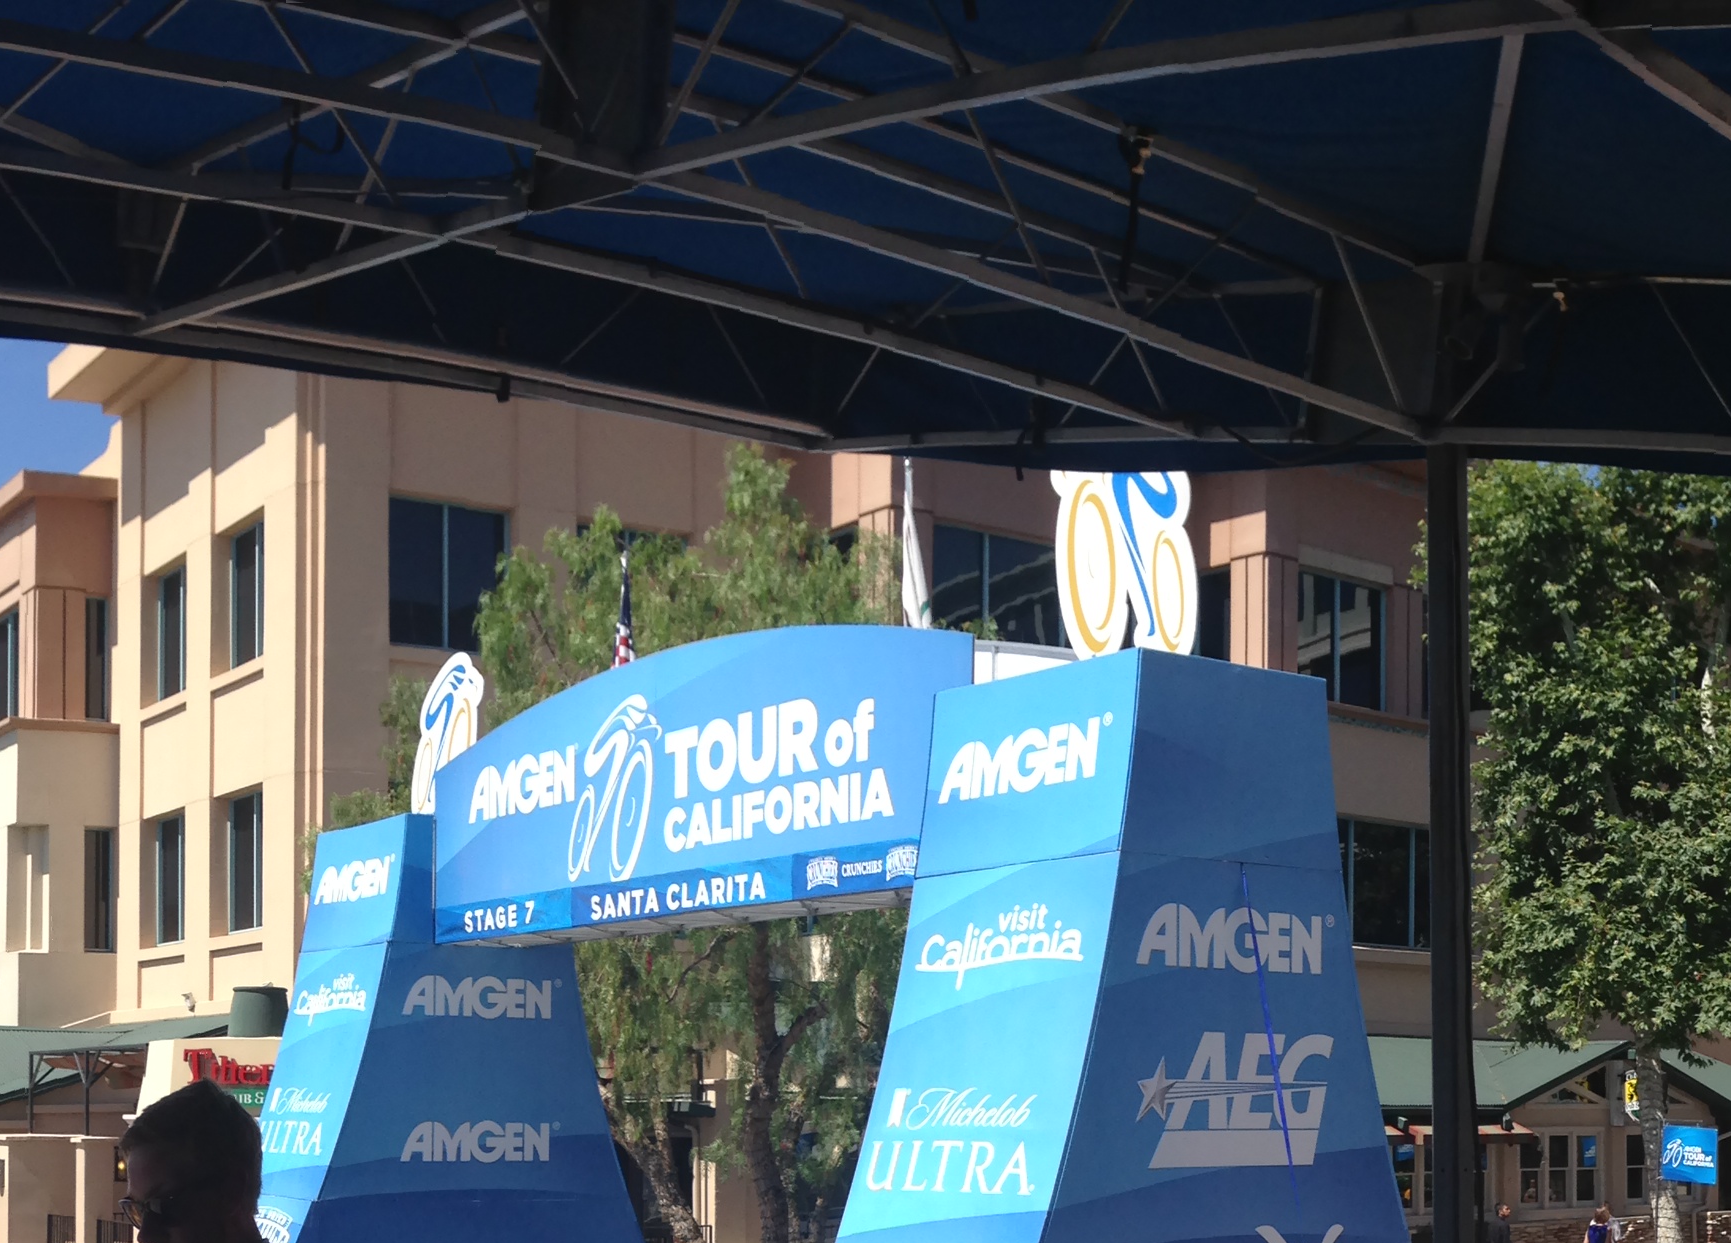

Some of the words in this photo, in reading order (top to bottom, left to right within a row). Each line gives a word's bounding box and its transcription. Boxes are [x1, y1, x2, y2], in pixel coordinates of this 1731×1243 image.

[664, 698, 819, 799] TOUR
[824, 698, 875, 768] of
[938, 716, 1101, 805] AMGEN
[468, 743, 576, 824] AMGEN
[663, 768, 895, 853] CALIFORNIA
[314, 855, 389, 905] AMGEN
[841, 860, 883, 878] CRUNCHIES
[464, 908, 518, 934] STAGE
[524, 901, 536, 925] 7
[590, 885, 659, 926] SANTA
[666, 872, 766, 912] CLARITA
[998, 902, 1048, 934] visit
[915, 920, 1084, 990] California
[1136, 903, 1323, 974] AMGEN
[333, 973, 355, 990] visit
[402, 975, 552, 1020] AMGEN
[294, 984, 366, 1027] California
[255, 1092, 265, 1104] &
[276, 1087, 331, 1116] Michelob
[1164, 1032, 1335, 1130] AEG
[907, 1087, 1038, 1130] Michelob
[261, 1119, 322, 1156] ULTRA
[400, 1119, 550, 1162] AMGEN
[1684, 1152, 1705, 1161] TOUR
[866, 1139, 1032, 1196] ULTRA
[1683, 1160, 1714, 1168] CALIFORNIA
